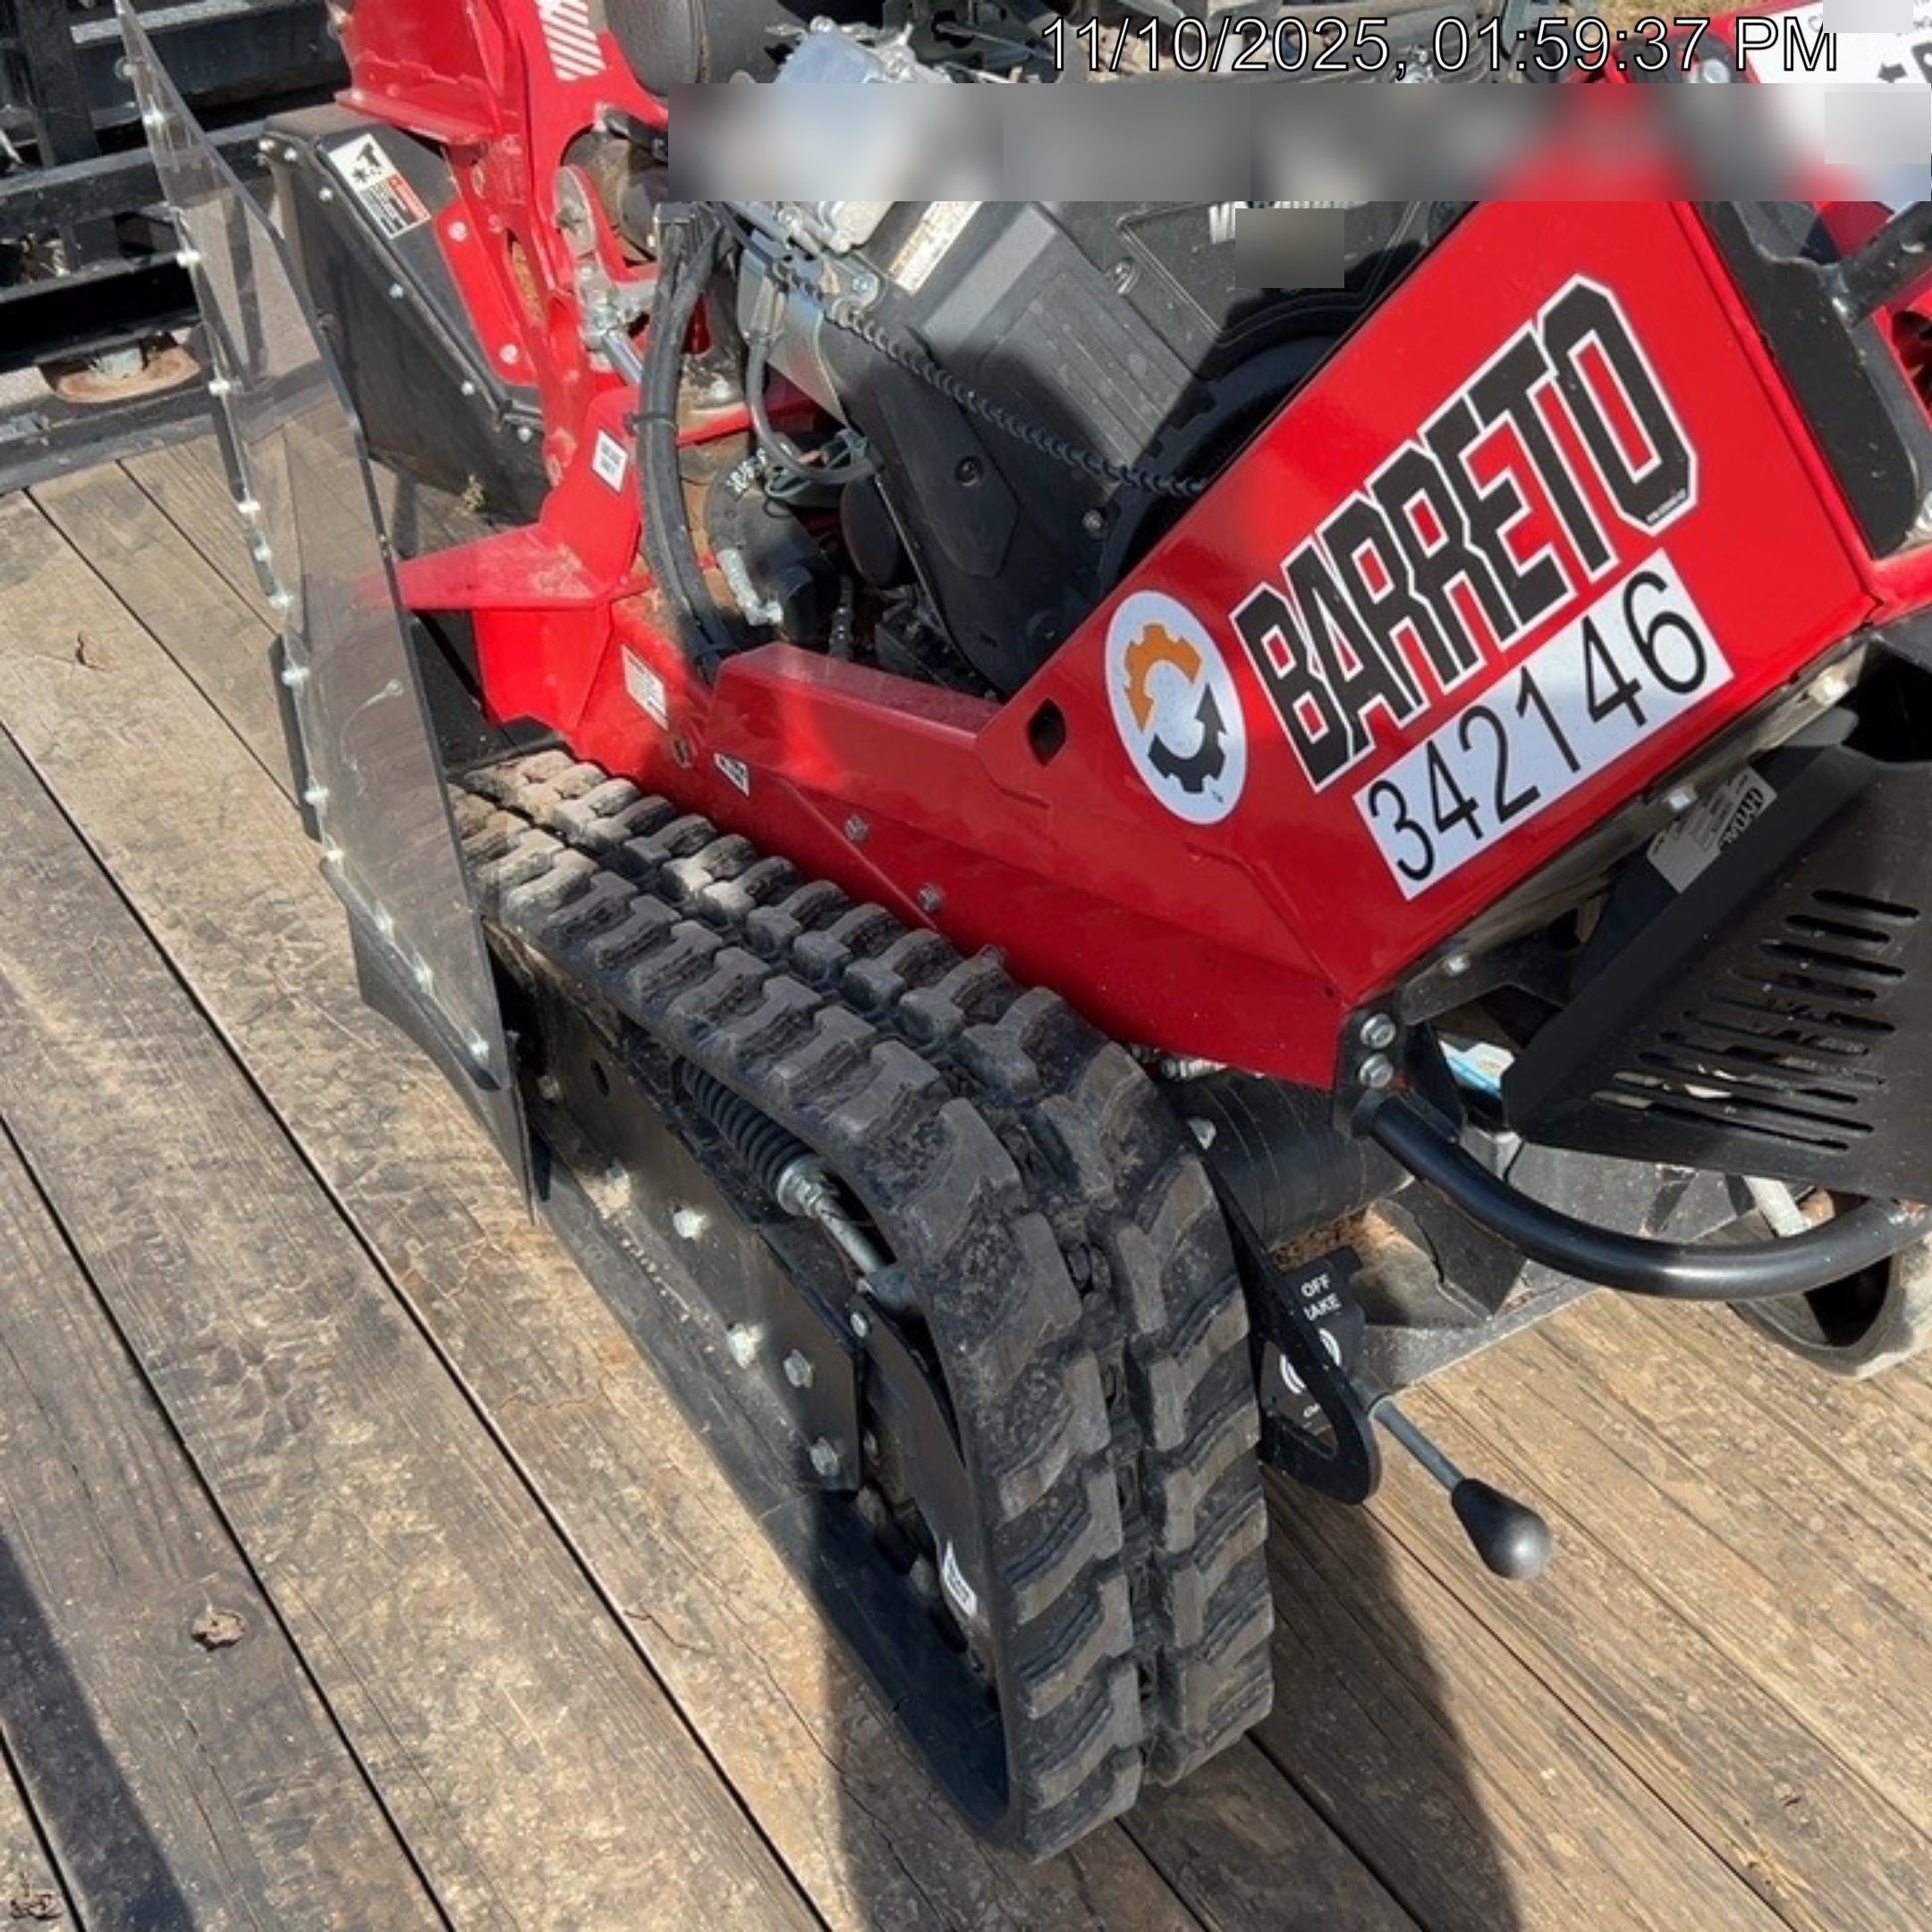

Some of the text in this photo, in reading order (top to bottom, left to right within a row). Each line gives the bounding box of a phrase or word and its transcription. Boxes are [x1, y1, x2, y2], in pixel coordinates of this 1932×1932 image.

[1230, 274, 1697, 792] BARRETO
[1368, 570, 1708, 883] 342146
[1301, 1274, 1330, 1297] OFF
